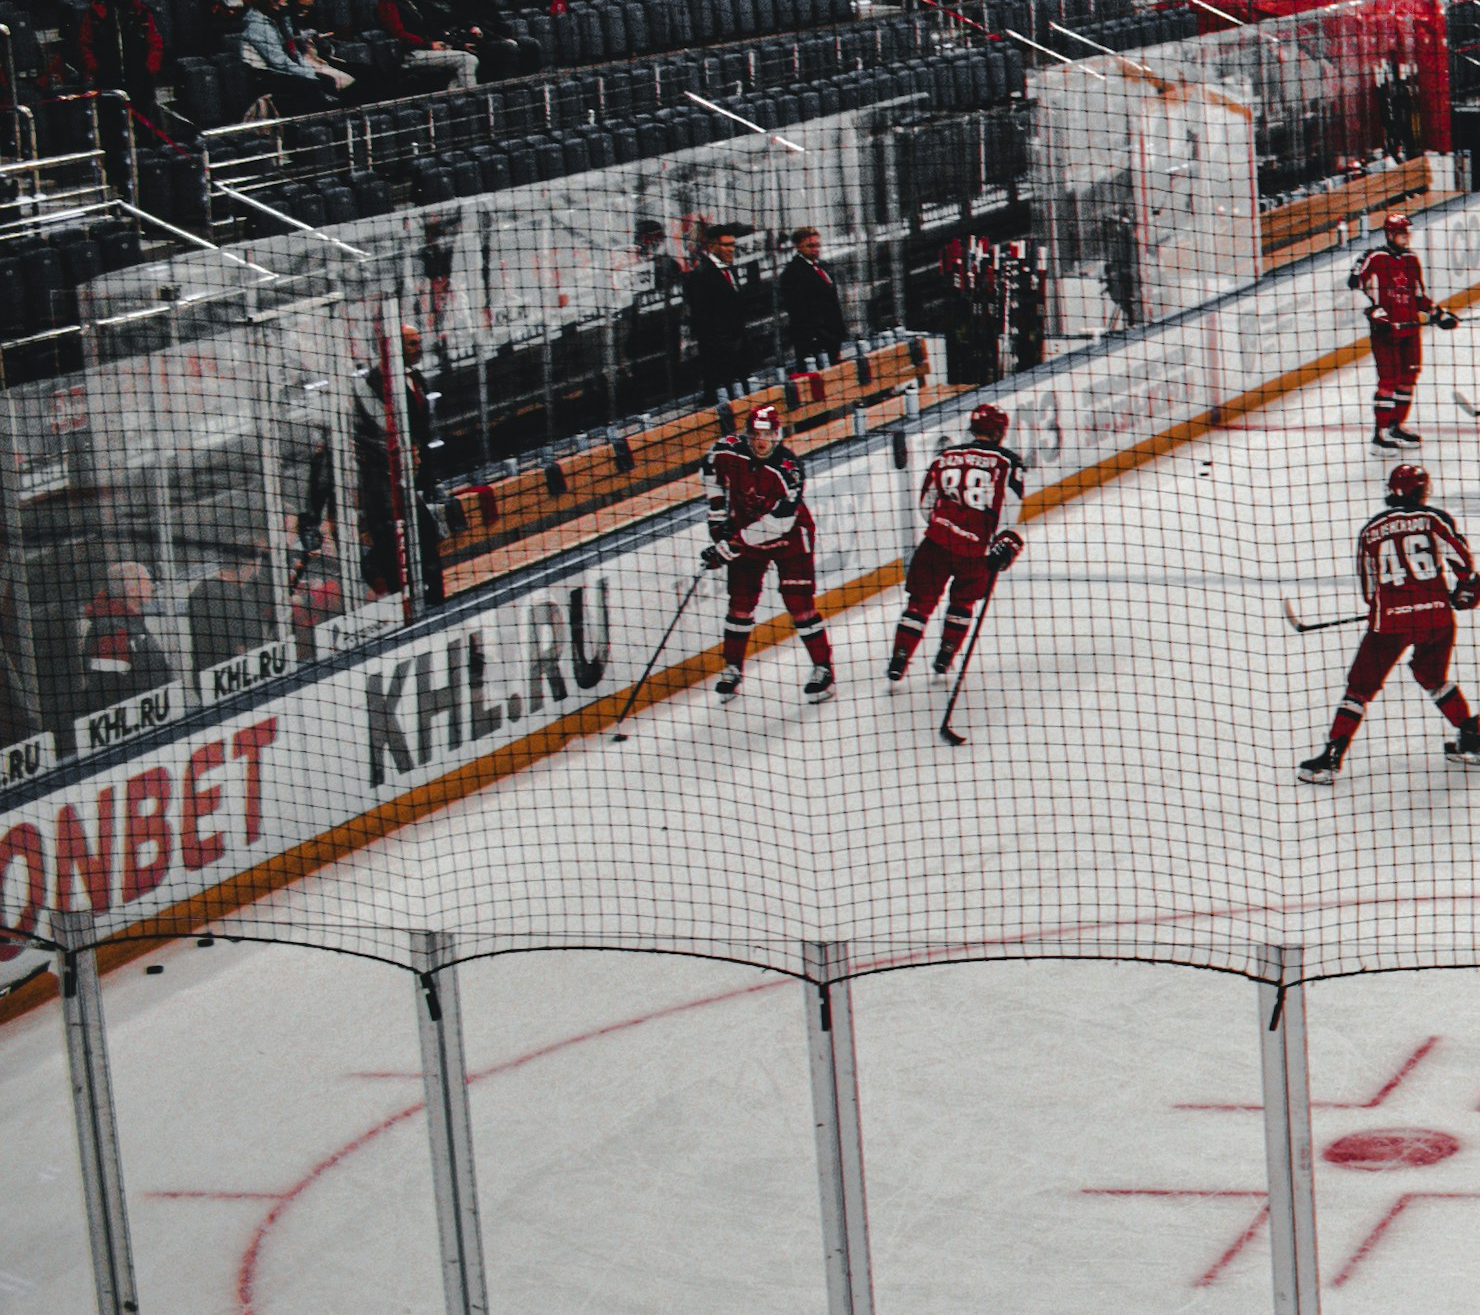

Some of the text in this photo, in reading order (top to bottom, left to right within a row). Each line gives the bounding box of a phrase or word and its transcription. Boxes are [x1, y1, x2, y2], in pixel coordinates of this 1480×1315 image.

[1377, 533, 1438, 587] 46
[212, 642, 288, 700] KHL.RU
[367, 578, 610, 789] KHL.RU
[89, 688, 171, 749] KHL.RU
[0, 715, 277, 935] ONBET
